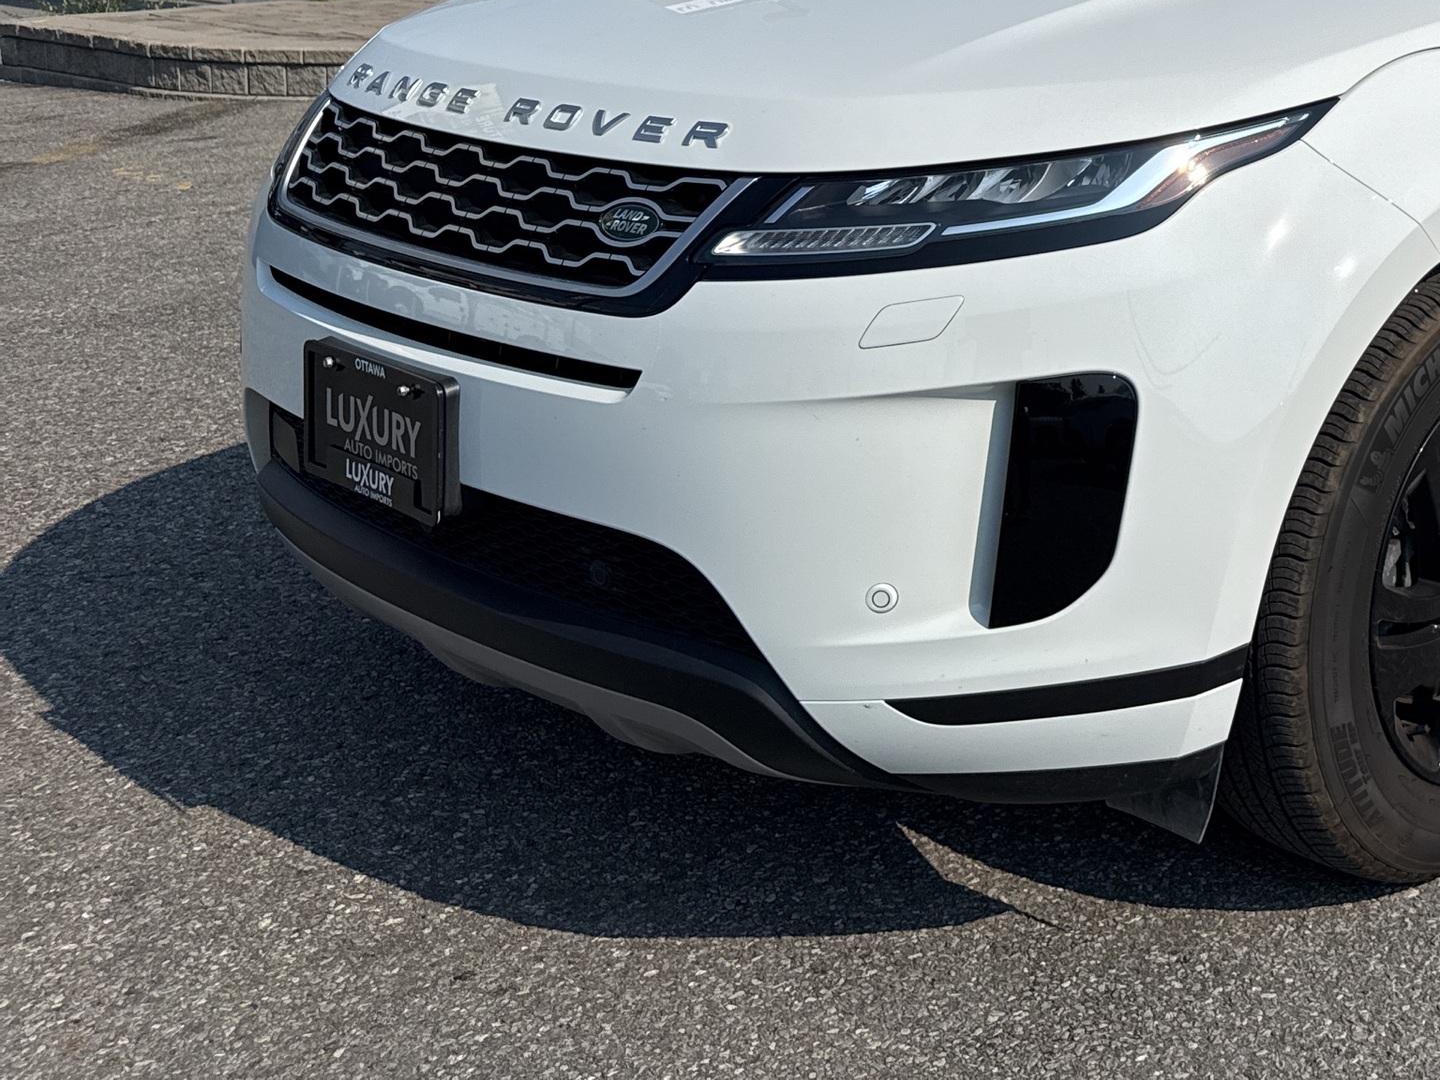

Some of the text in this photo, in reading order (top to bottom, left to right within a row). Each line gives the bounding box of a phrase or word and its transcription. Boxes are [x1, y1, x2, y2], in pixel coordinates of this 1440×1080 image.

[347, 63, 481, 115] RANGE
[503, 97, 731, 149] ROVER
[610, 208, 648, 235] LAND ROVER
[354, 357, 386, 379] OTTAWA
[326, 387, 421, 459] LUXURY
[344, 438, 418, 480] AUTO IMPORTS
[345, 458, 394, 496] LUXURY
[354, 485, 393, 508] AUTO IMPORTS
